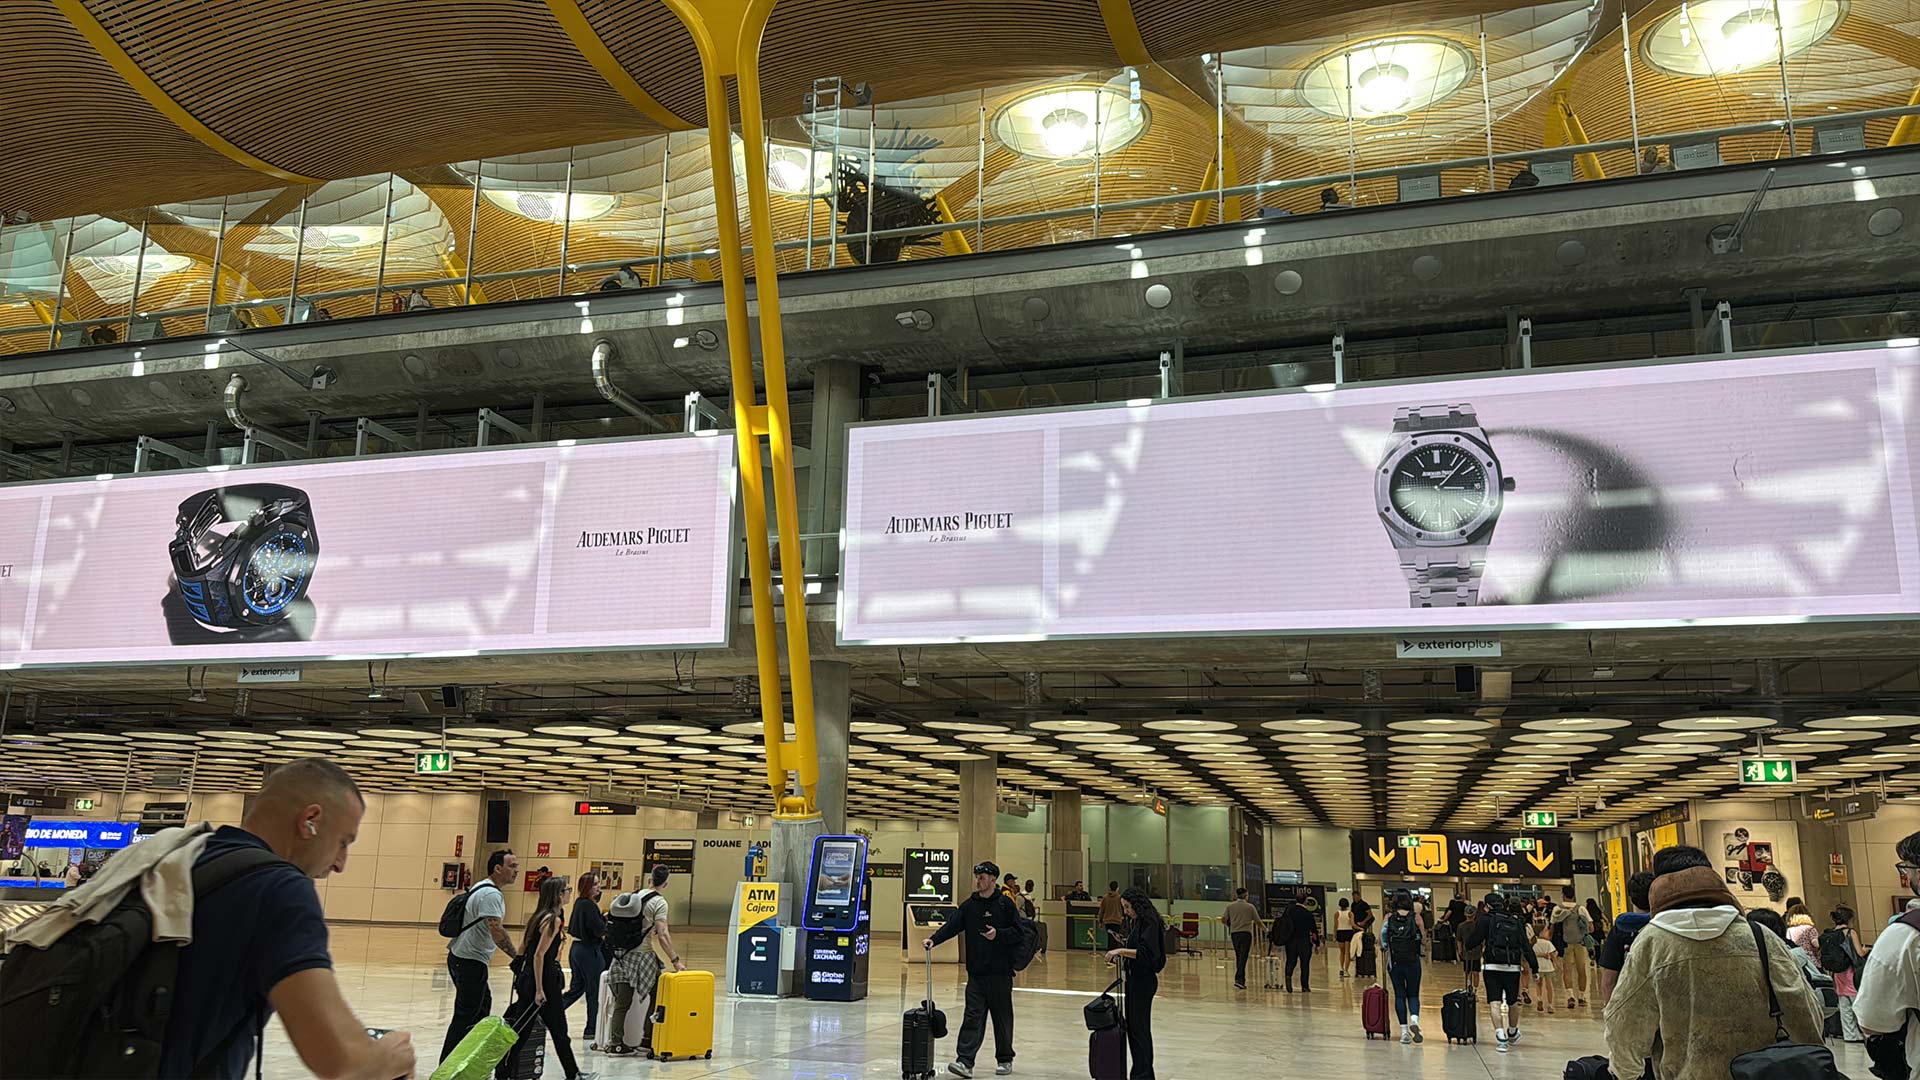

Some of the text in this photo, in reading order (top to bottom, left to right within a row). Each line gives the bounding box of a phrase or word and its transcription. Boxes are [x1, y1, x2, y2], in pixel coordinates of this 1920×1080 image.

[885, 512, 1014, 534] AUDEMARS PIGUET
[576, 527, 691, 548] AUDEMARS PIGUET
[928, 534, 967, 543] Le Brassus
[625, 548, 649, 556] Brassus
[1417, 639, 1494, 651] exteriorplus
[250, 666, 296, 677] exteriorplus
[40, 829, 52, 839] DE
[52, 830, 88, 840] MONEDA
[703, 840, 742, 848] DOUANE
[1457, 839, 1516, 857] Way out
[930, 850, 950, 861] info
[1459, 858, 1508, 873] Salida
[748, 889, 776, 901] ATM
[746, 902, 776, 914] Cajero
[821, 971, 845, 979] Global
